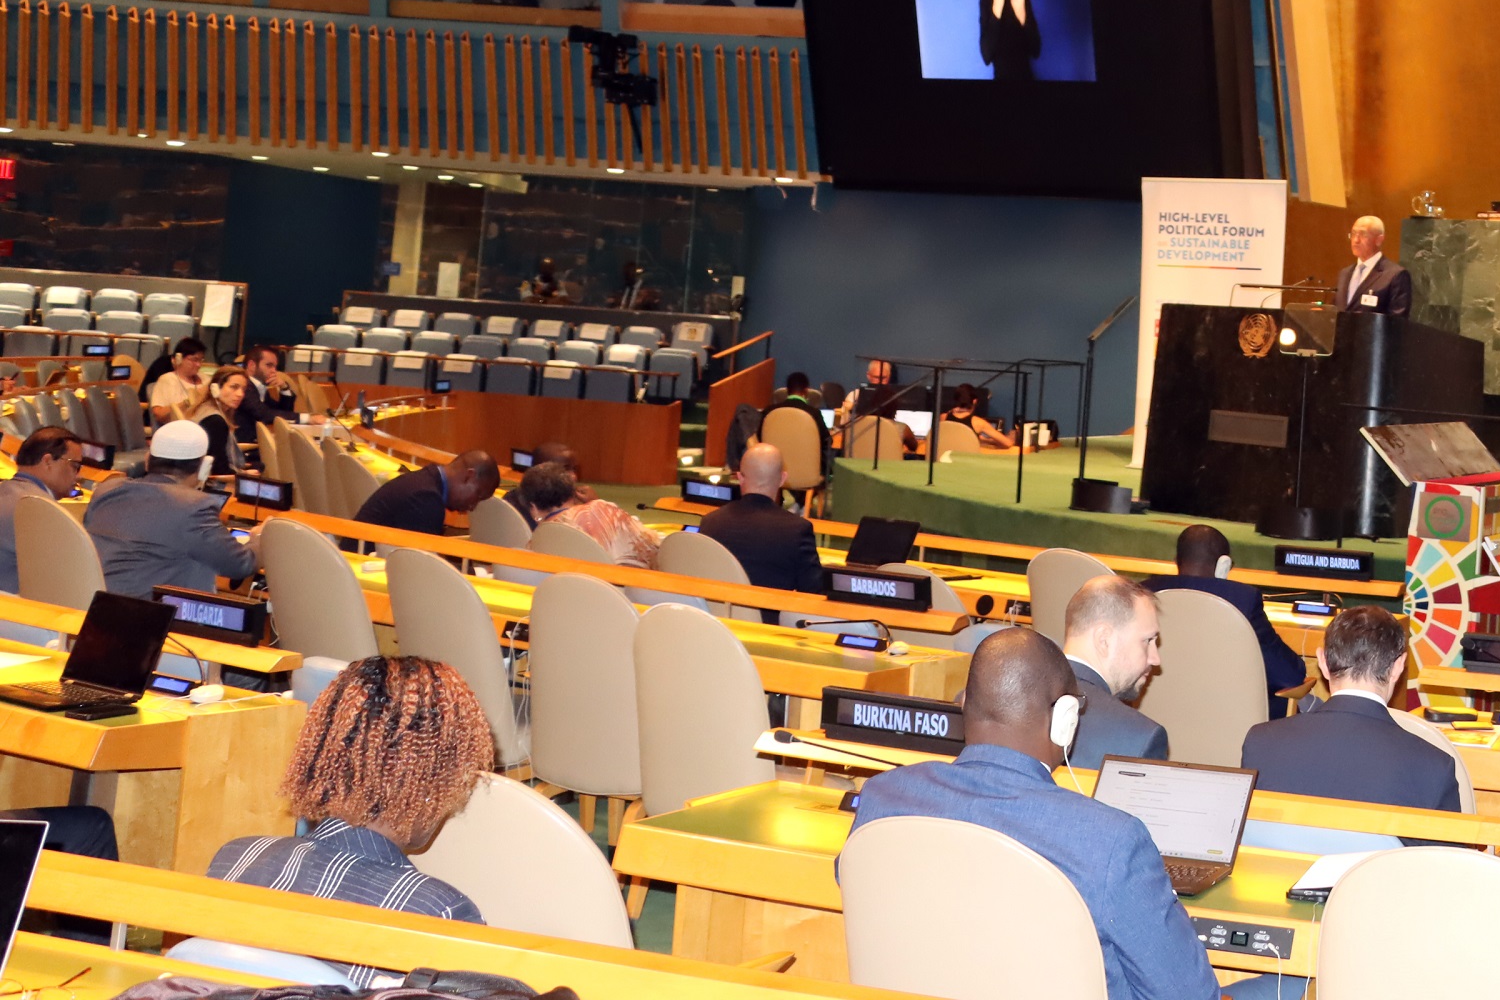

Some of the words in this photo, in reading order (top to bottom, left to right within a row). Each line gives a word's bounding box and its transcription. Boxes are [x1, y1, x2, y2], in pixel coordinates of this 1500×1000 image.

[1159, 212, 1230, 224] HIGH-LEVEL
[1158, 224, 1219, 236] POLITICAL
[1222, 226, 1265, 237] FORUM
[1170, 238, 1251, 250] SUSTAINABLE
[1157, 249, 1245, 262] DEVELOPMENT
[1285, 553, 1313, 566] ANTIGUA
[1315, 556, 1329, 567] AND
[1330, 557, 1360, 570] BARBUDA
[851, 577, 896, 597] BARBADOS
[181, 602, 223, 627] BULGARIA
[853, 703, 911, 732] BURKINA
[914, 712, 949, 737] FASO
